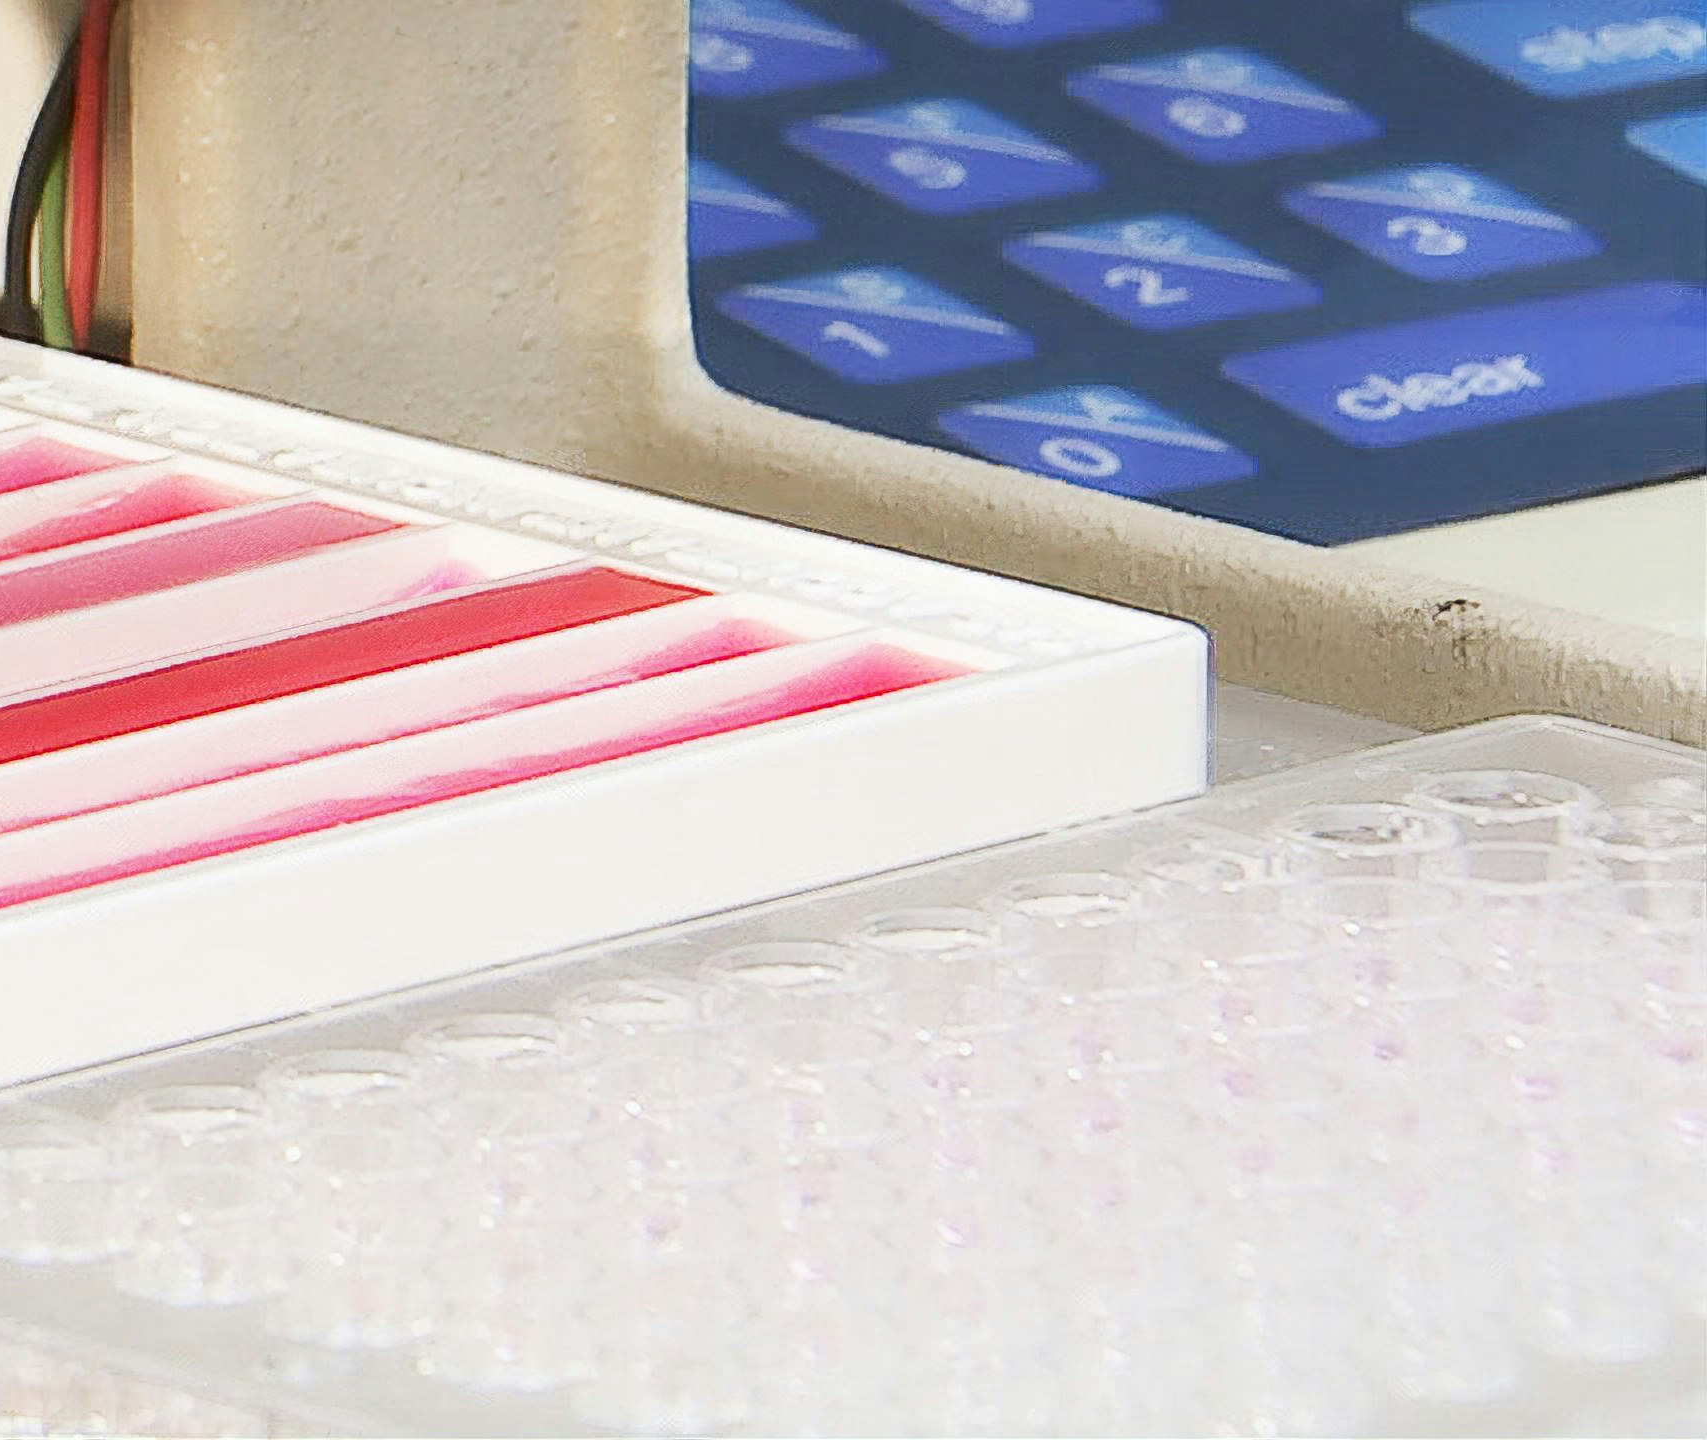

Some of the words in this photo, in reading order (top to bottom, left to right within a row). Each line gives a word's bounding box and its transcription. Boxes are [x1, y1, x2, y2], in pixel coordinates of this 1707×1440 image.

[1387, 215, 1468, 256] 3
[1102, 264, 1192, 307] 2
[821, 319, 891, 358] 1
[1335, 353, 1546, 421] clear
[1038, 436, 1124, 478] 0
